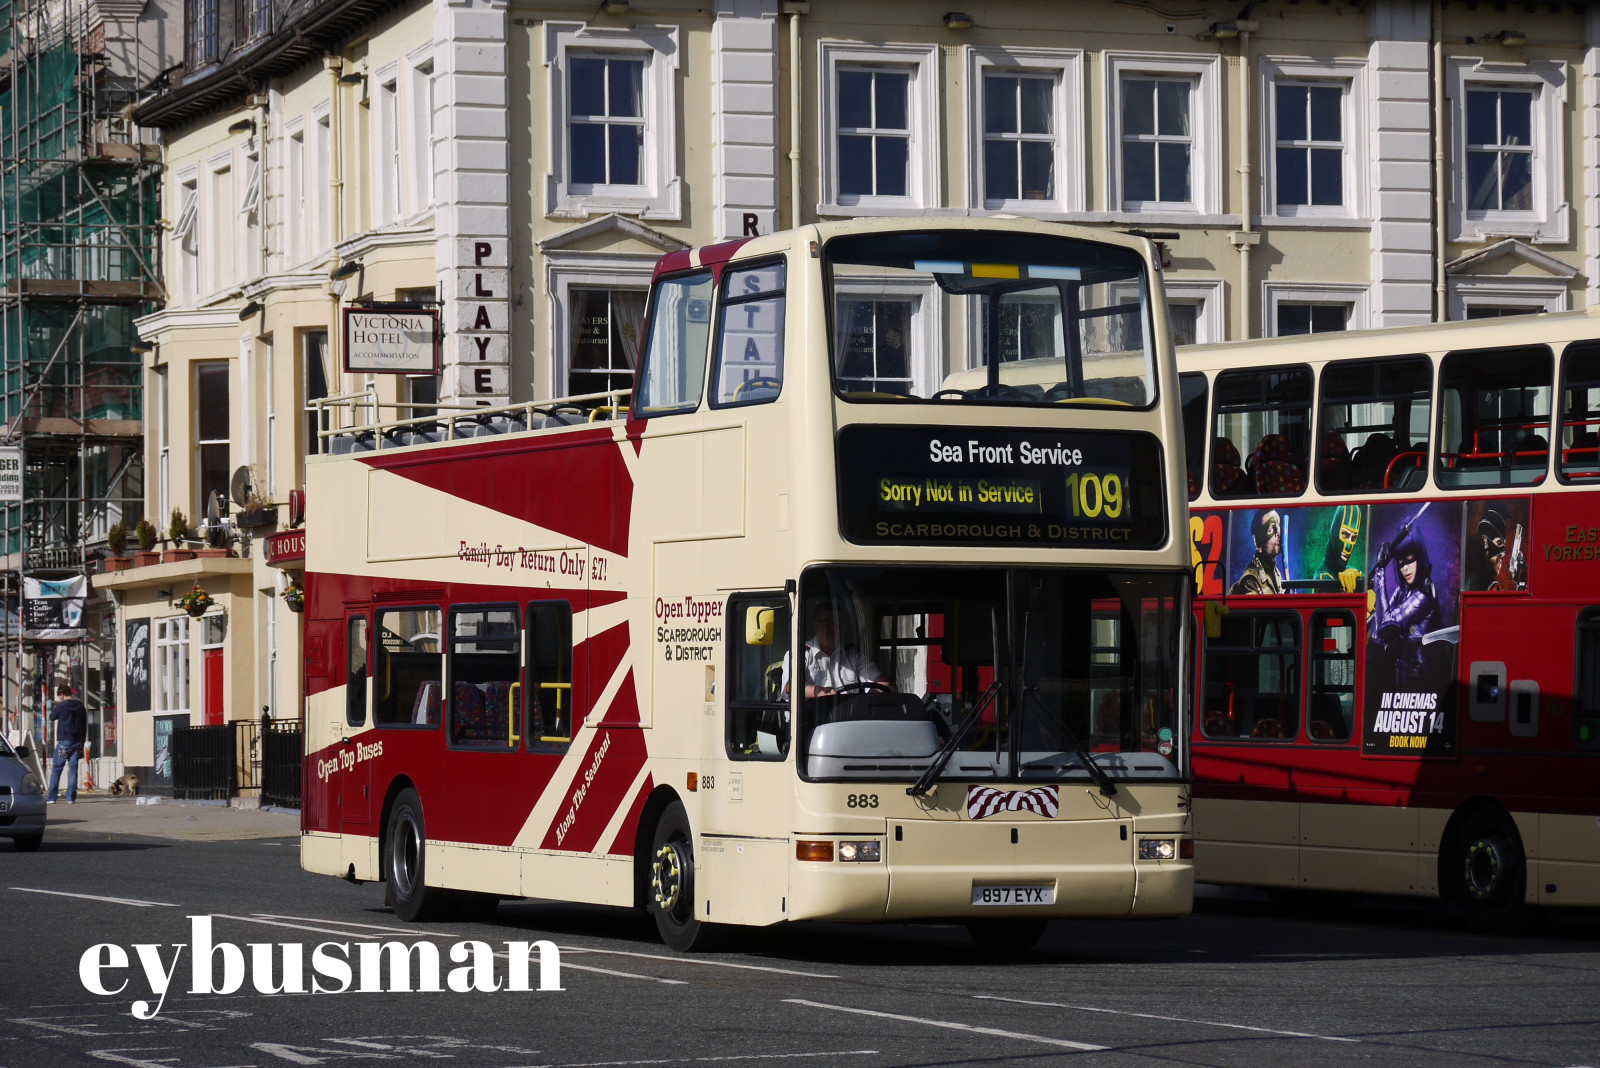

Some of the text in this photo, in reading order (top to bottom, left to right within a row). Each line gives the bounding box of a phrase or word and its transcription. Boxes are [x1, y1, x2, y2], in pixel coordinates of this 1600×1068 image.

[352, 315, 424, 330] VICTORIA
[593, 326, 600, 335] &
[353, 331, 403, 344] HOTEL
[929, 439, 1083, 466] Sea Front Service
[880, 477, 1034, 506] Sorry Not in Service
[1065, 472, 1123, 518] 109
[875, 521, 1132, 541] SCARBOROUGH & DISTRICT
[1566, 525, 1600, 543] EAS
[458, 540, 608, 582] Family Day Return Only £7!
[655, 596, 723, 624] Open Topper
[657, 626, 722, 643] SCARBOROUGH
[665, 644, 713, 661] & DISTRICT
[1381, 692, 1438, 710] IN CINEMAS
[1373, 711, 1445, 734] AUGUST 14
[1389, 735, 1428, 749] BOOK NOW
[317, 740, 383, 783] Open Top Buses
[555, 730, 611, 847] Along The Seafront
[702, 775, 715, 789] 883
[847, 793, 880, 809] 883
[982, 887, 1043, 903] 897 EYX
